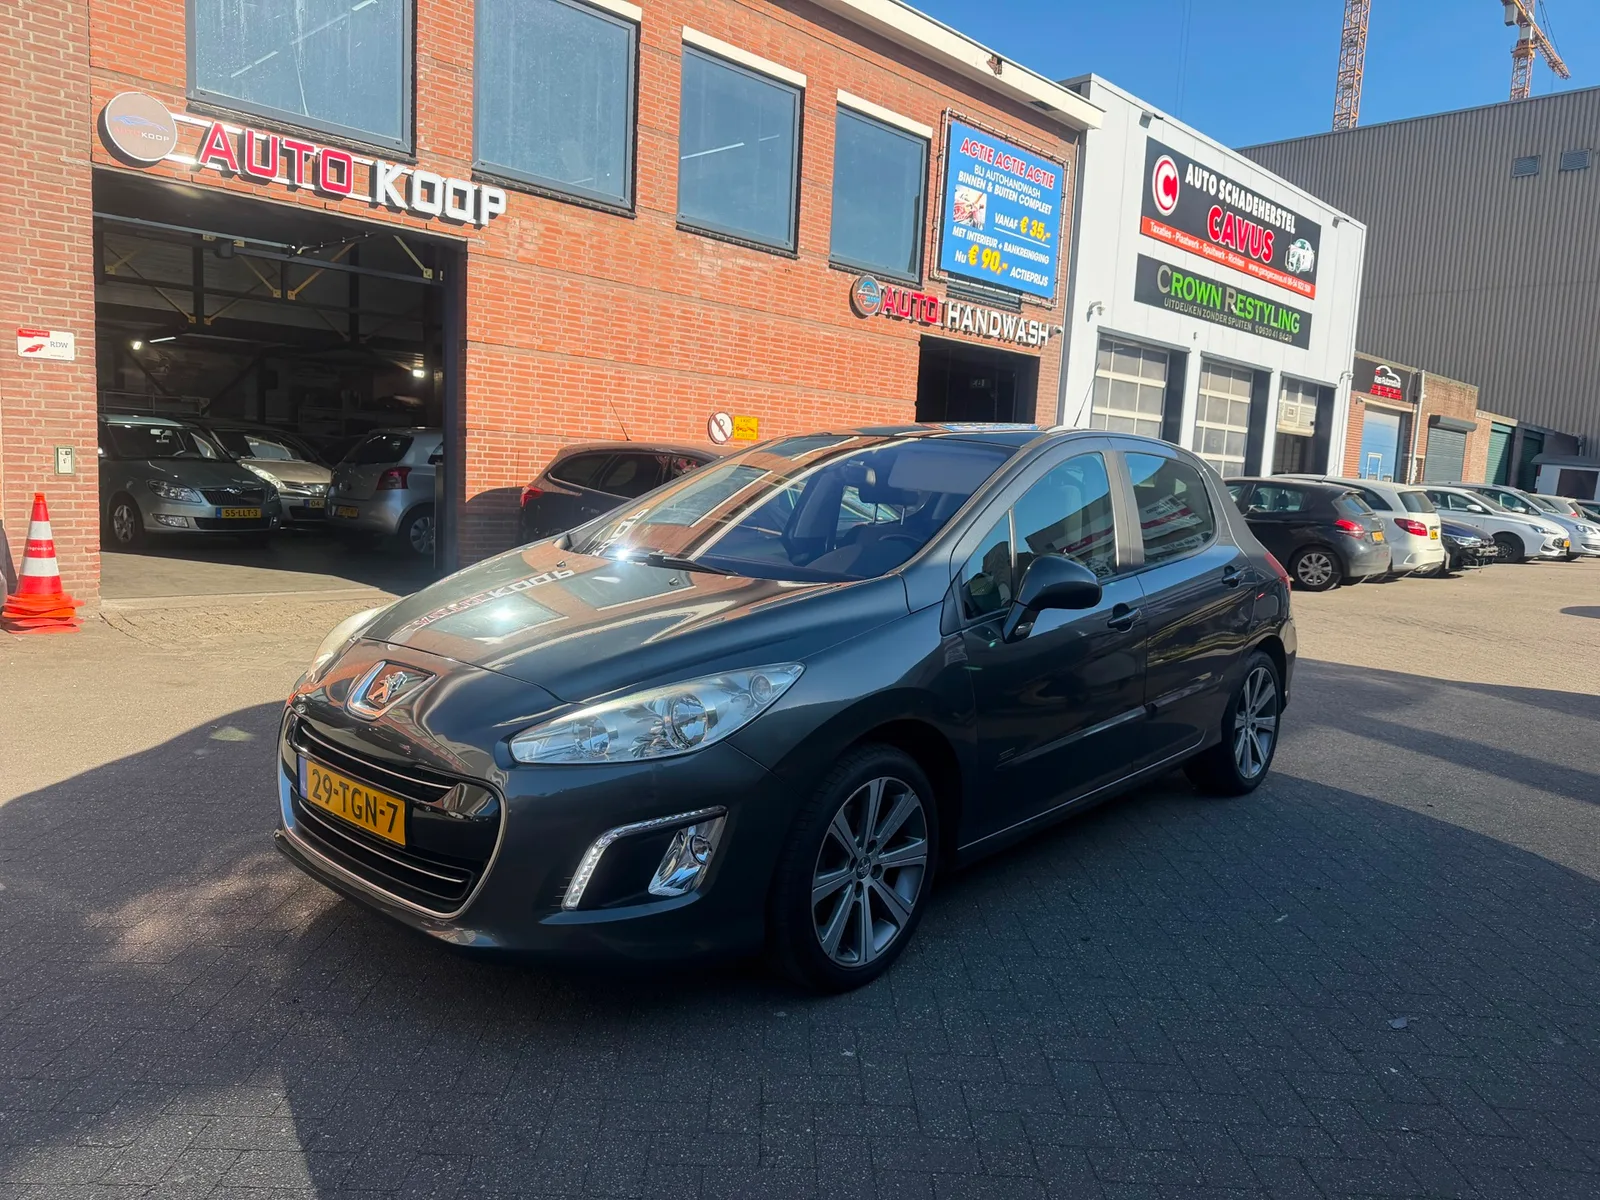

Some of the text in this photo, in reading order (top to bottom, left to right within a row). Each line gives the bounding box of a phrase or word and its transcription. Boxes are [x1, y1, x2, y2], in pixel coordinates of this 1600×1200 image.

[142, 132, 169, 141] KOOP
[199, 123, 507, 225] AUTO KOOP
[960, 138, 1055, 190] ACTIE ACTIE ACTIE
[985, 168, 1041, 197] AUTOHANDWASH
[958, 171, 1052, 215] BINNEN & BUITEN COMPLEET
[1185, 163, 1295, 234] AUTO SCHADEHERSTEL
[952, 226, 965, 237] MET
[967, 229, 997, 248] INTERIEUR
[1004, 242, 1049, 265] BANKREINIGING
[994, 213, 1019, 229] VANAF
[1020, 216, 1028, 234] €
[1207, 205, 1275, 263] CAVUS
[967, 244, 979, 265] €
[1010, 266, 1048, 286] ACTIEPRIJS
[881, 286, 1050, 346] AUTO HANDWASH
[1156, 264, 1300, 333] CROWN RESTYLING
[1164, 298, 1202, 316] UITDEUKEN
[1202, 307, 1228, 324] ZONDER
[1228, 313, 1252, 331] SPUITEN
[312, 768, 398, 833] 29-TGN-7
